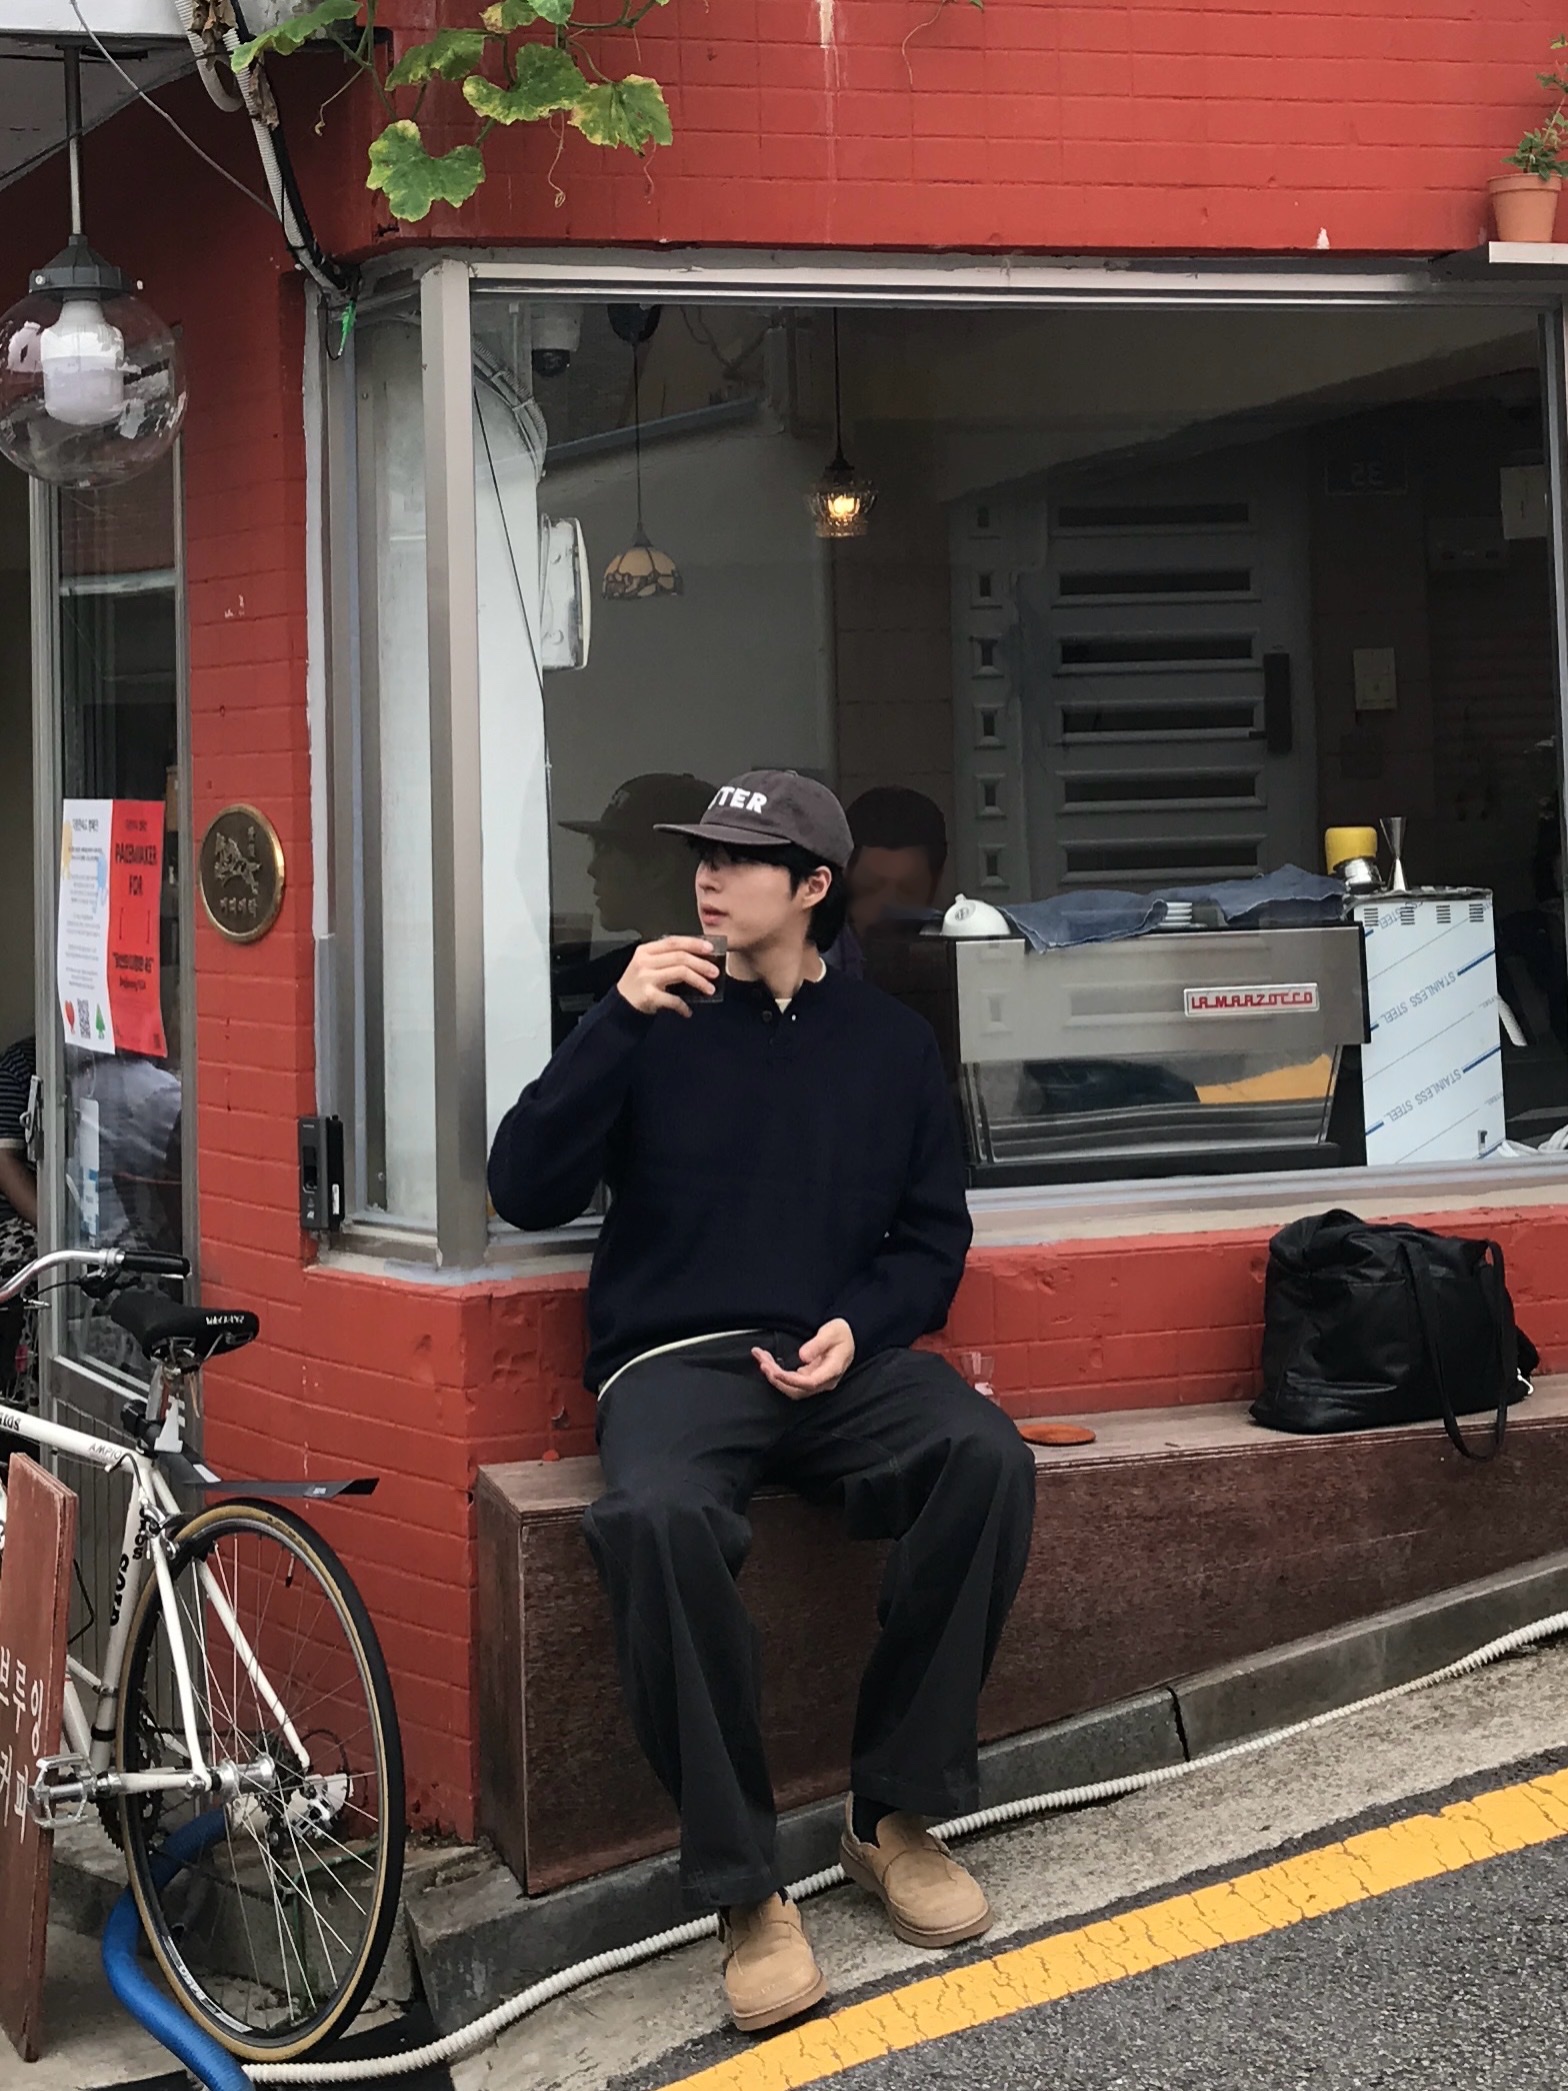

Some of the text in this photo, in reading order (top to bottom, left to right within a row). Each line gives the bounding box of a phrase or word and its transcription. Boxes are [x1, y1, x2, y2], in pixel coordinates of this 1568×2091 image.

[708, 786, 767, 814] TER
[1409, 971, 1457, 1008] STAINLESS
[1414, 1068, 1462, 1106] STAINLESS
